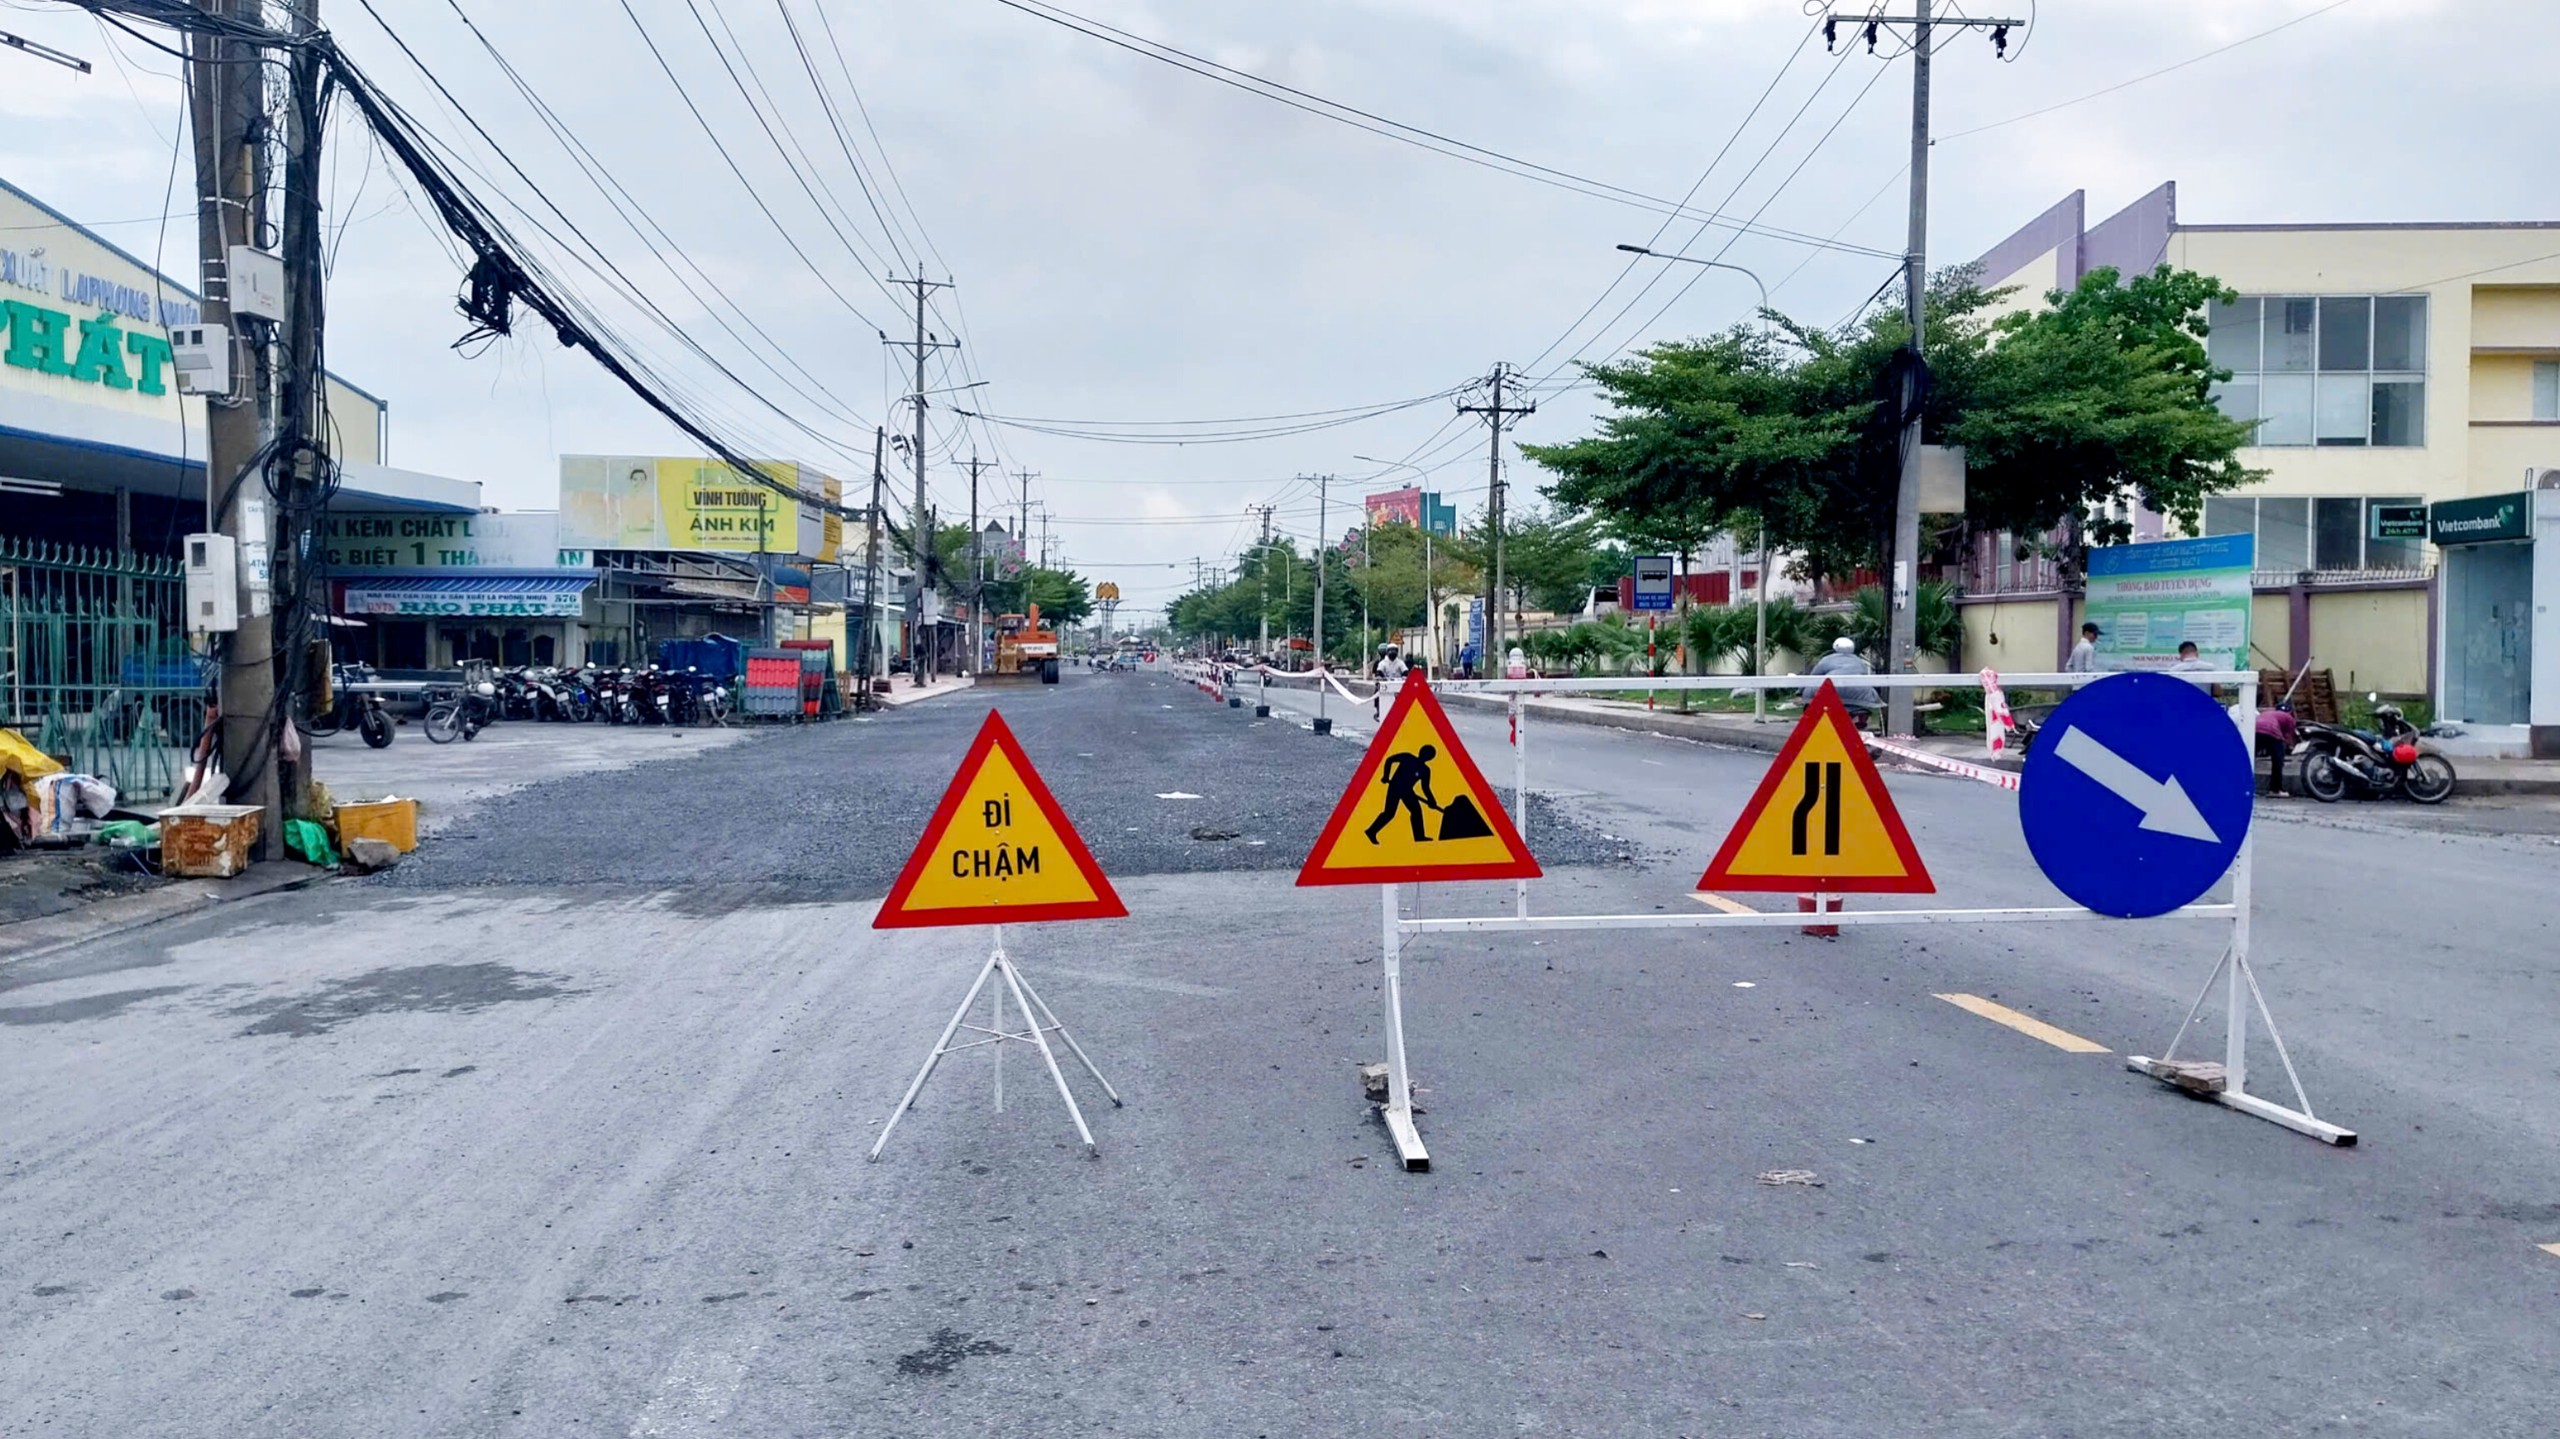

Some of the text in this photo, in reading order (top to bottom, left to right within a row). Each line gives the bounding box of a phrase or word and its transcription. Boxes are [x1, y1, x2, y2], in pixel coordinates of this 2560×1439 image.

[0, 299, 172, 396] HÁT
[740, 517, 774, 532] KIM
[2437, 516, 2501, 533] Vietcombank
[349, 546, 398, 569] BIỆT
[411, 542, 425, 565] 1
[555, 594, 577, 603] 576
[982, 793, 1011, 828] ĐI
[953, 842, 1040, 882] CHẬM
